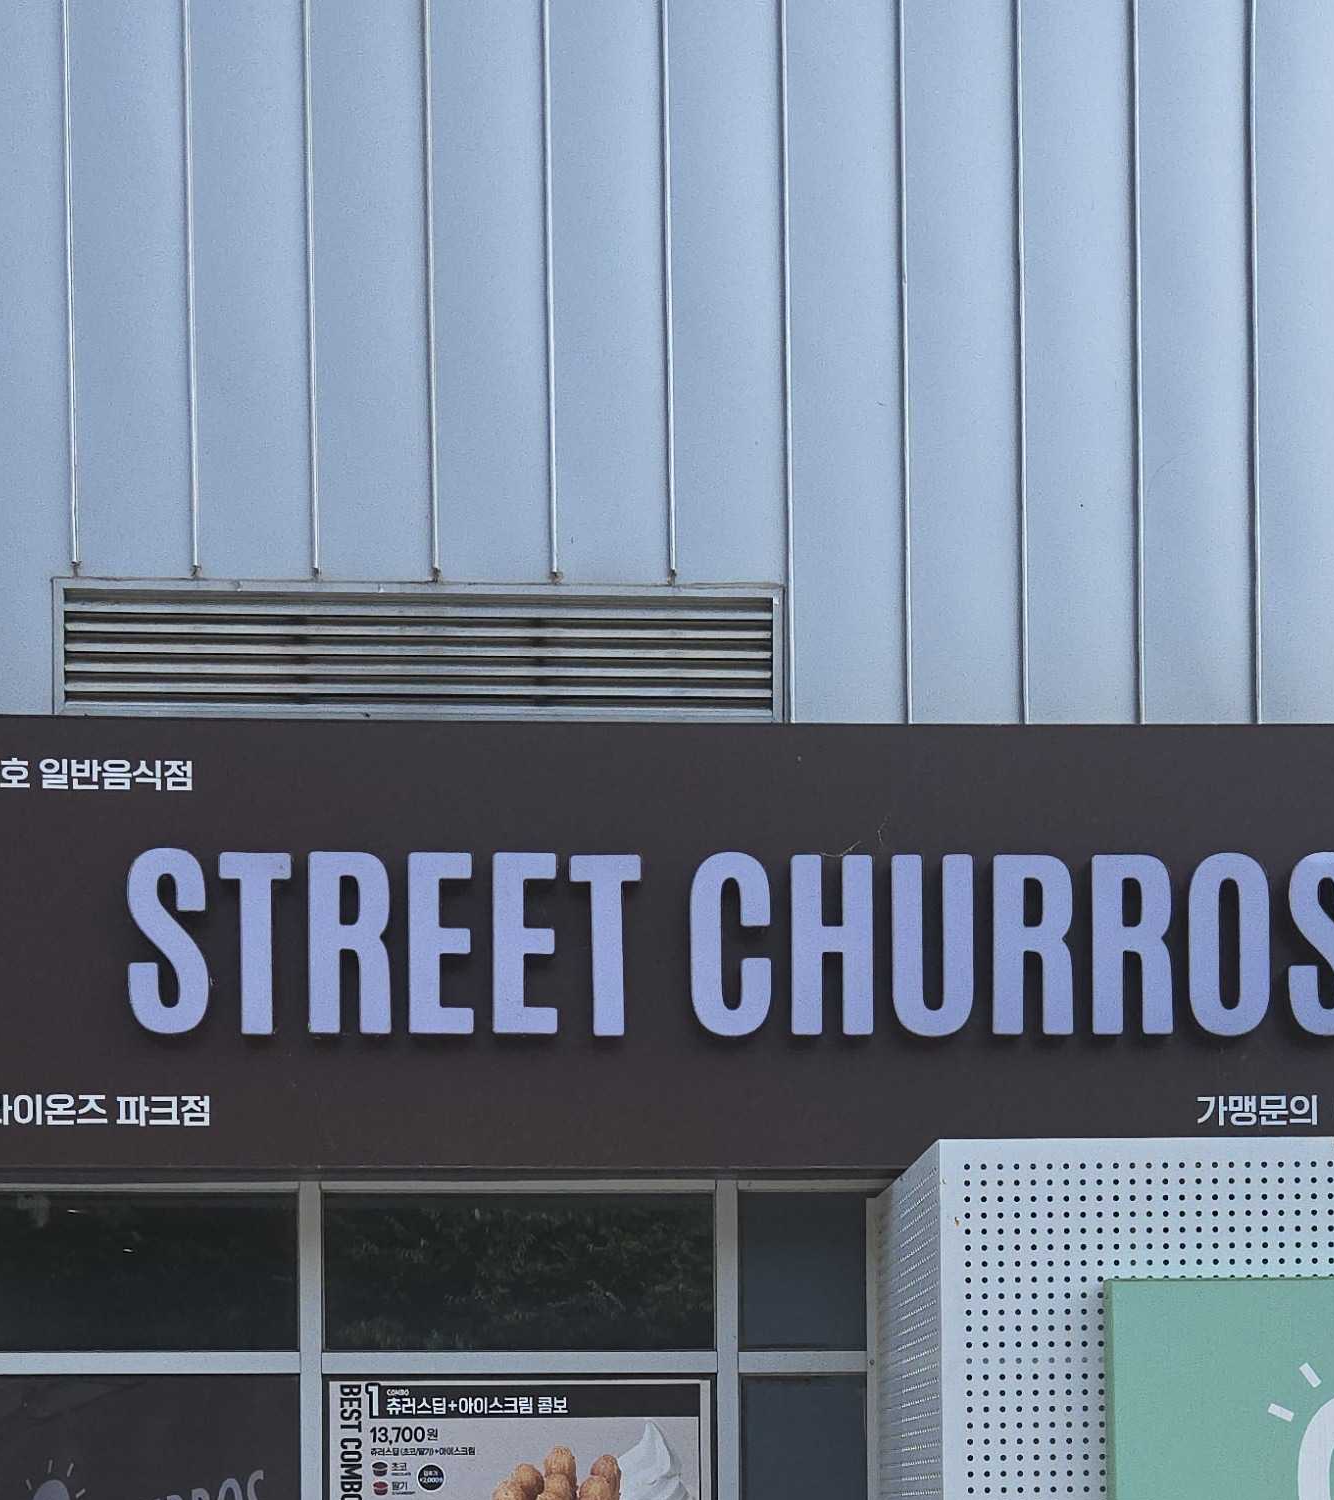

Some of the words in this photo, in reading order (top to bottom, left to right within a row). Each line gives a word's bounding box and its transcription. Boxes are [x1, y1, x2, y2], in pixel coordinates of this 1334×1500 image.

[39, 758, 193, 791] 일반음식점
[126, 847, 642, 1037] STREET
[116, 1094, 211, 1127] 파크점
[1196, 1094, 1319, 1126] 가맹문의
[339, 1384, 362, 1432] BEST
[537, 1396, 569, 1414] 콤보
[369, 1425, 439, 1446] 13,700원
